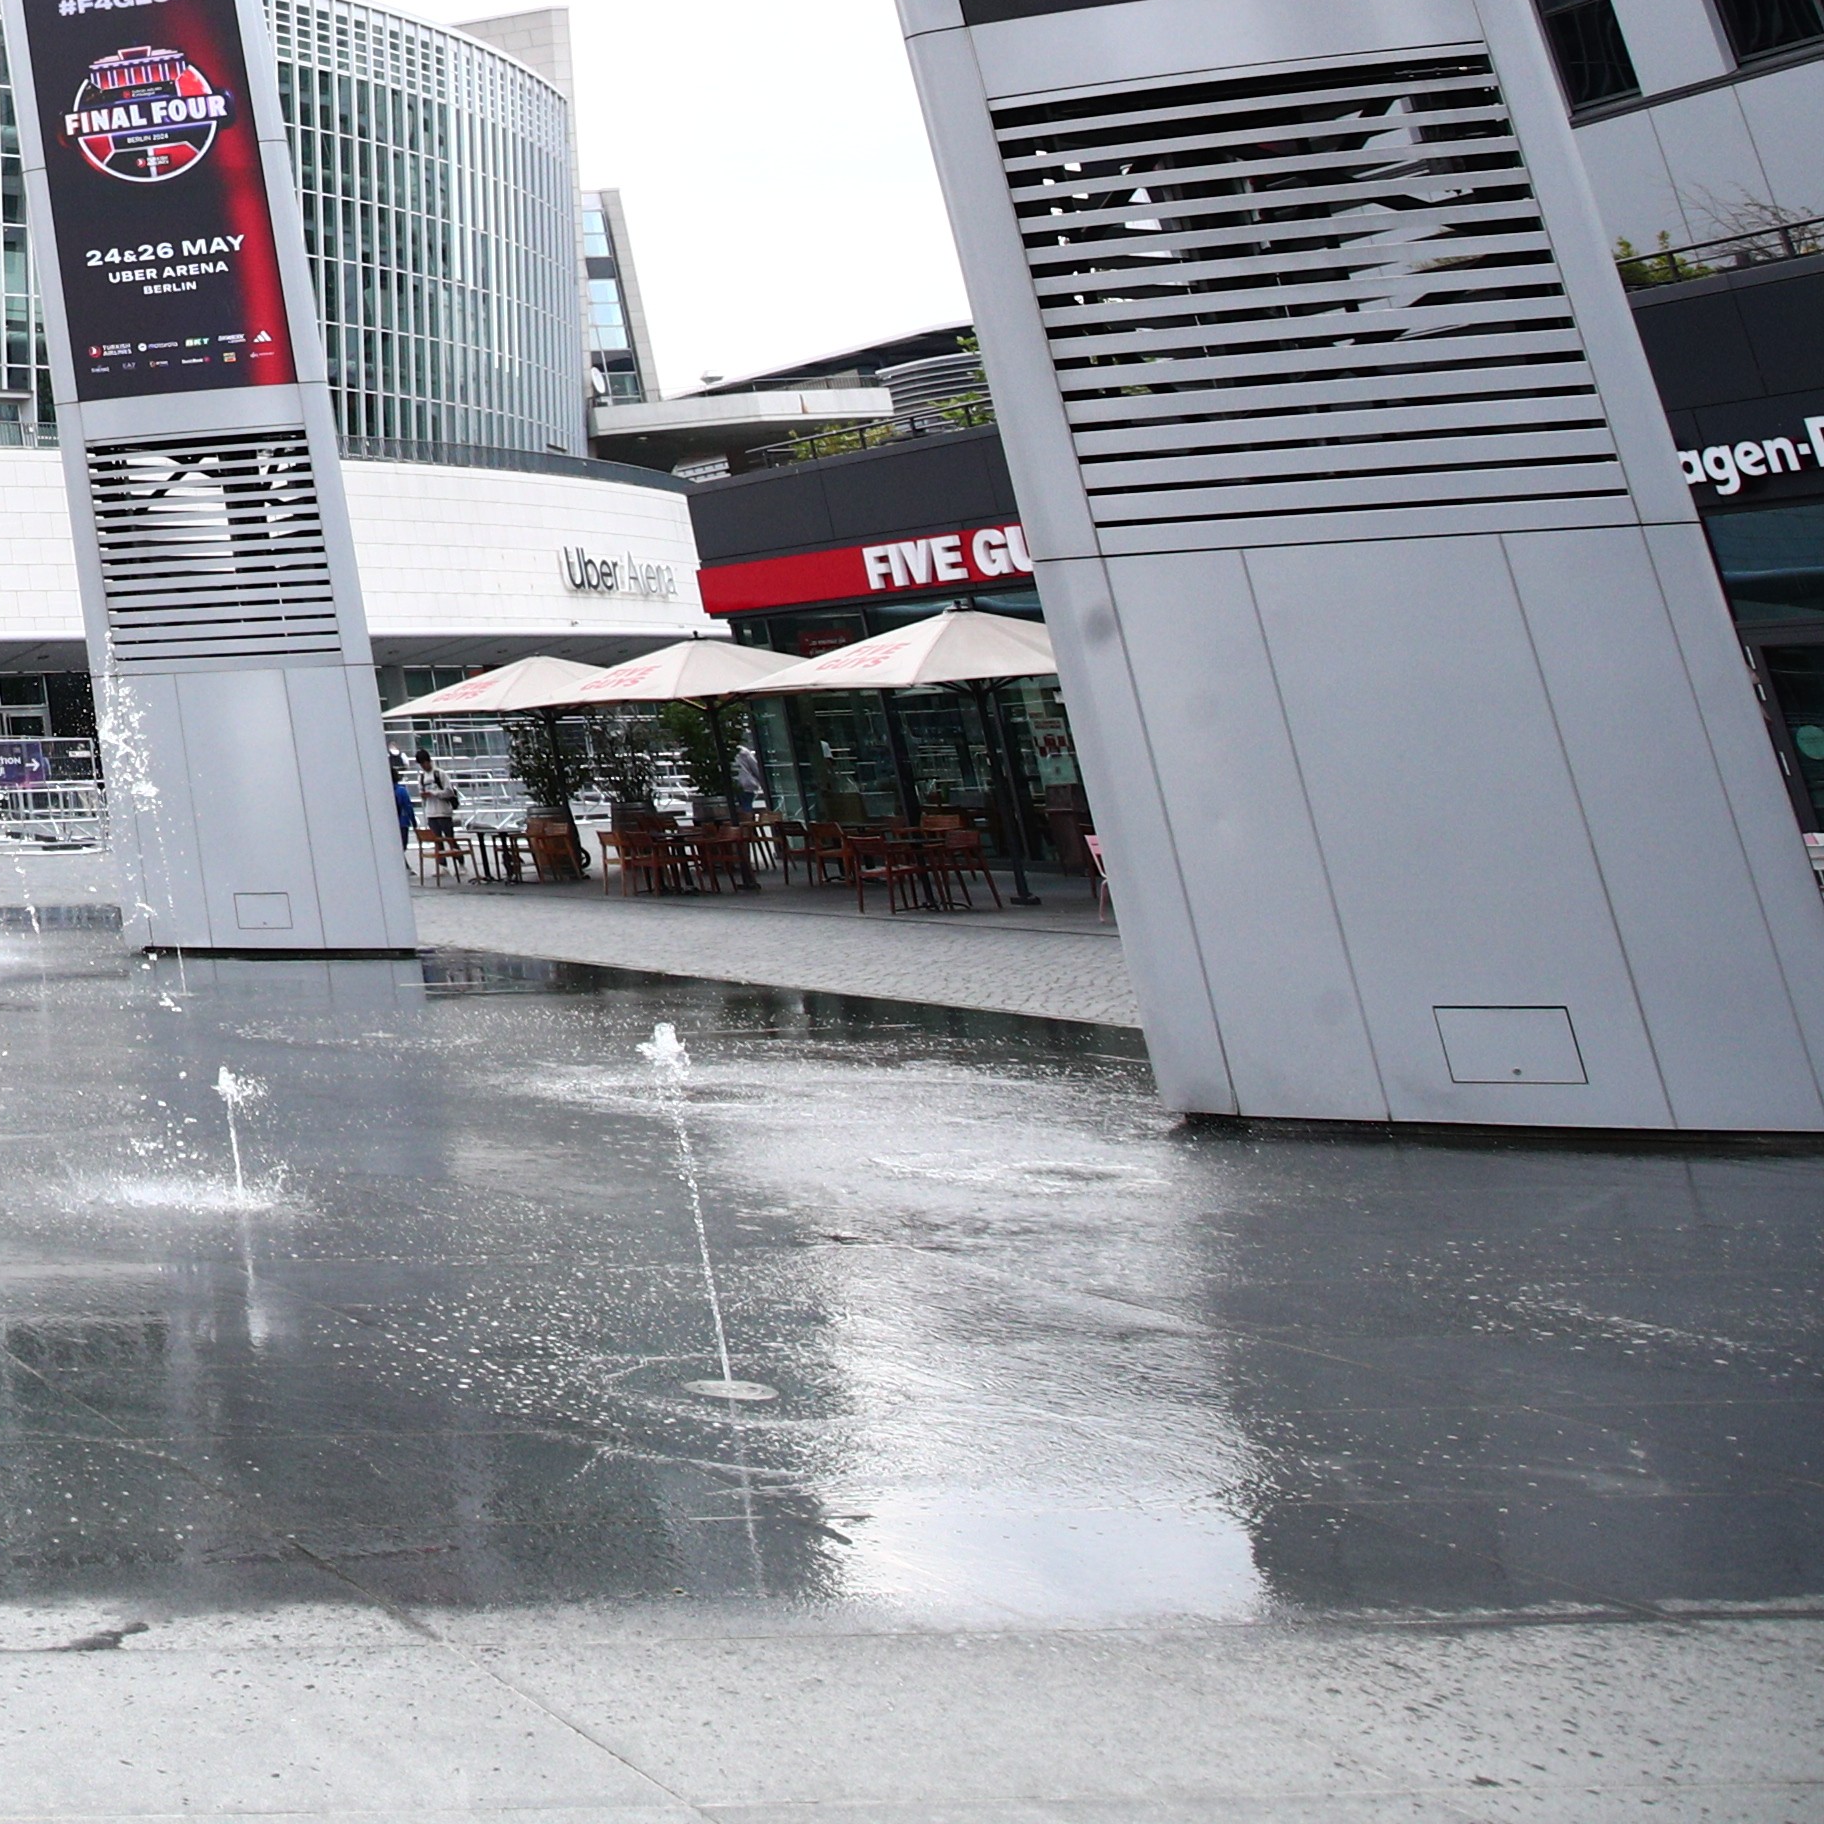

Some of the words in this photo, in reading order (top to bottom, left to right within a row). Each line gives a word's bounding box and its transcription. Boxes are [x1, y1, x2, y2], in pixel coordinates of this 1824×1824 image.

[65, 104, 147, 136] FINAL
[150, 95, 228, 124] FOUR
[85, 242, 174, 267] 24&26
[181, 234, 245, 256] MAY
[108, 268, 158, 284] UBER
[162, 260, 229, 278] ARENA
[143, 280, 197, 295] BERLIN
[862, 534, 969, 590] FIVE
[563, 546, 619, 591] Uber
[627, 550, 679, 596] Arena
[844, 642, 911, 658] FIVE
[604, 665, 661, 677] FIVE
[815, 655, 890, 671] GUYS
[580, 676, 647, 691] GUYS
[432, 690, 486, 703] GUYS
